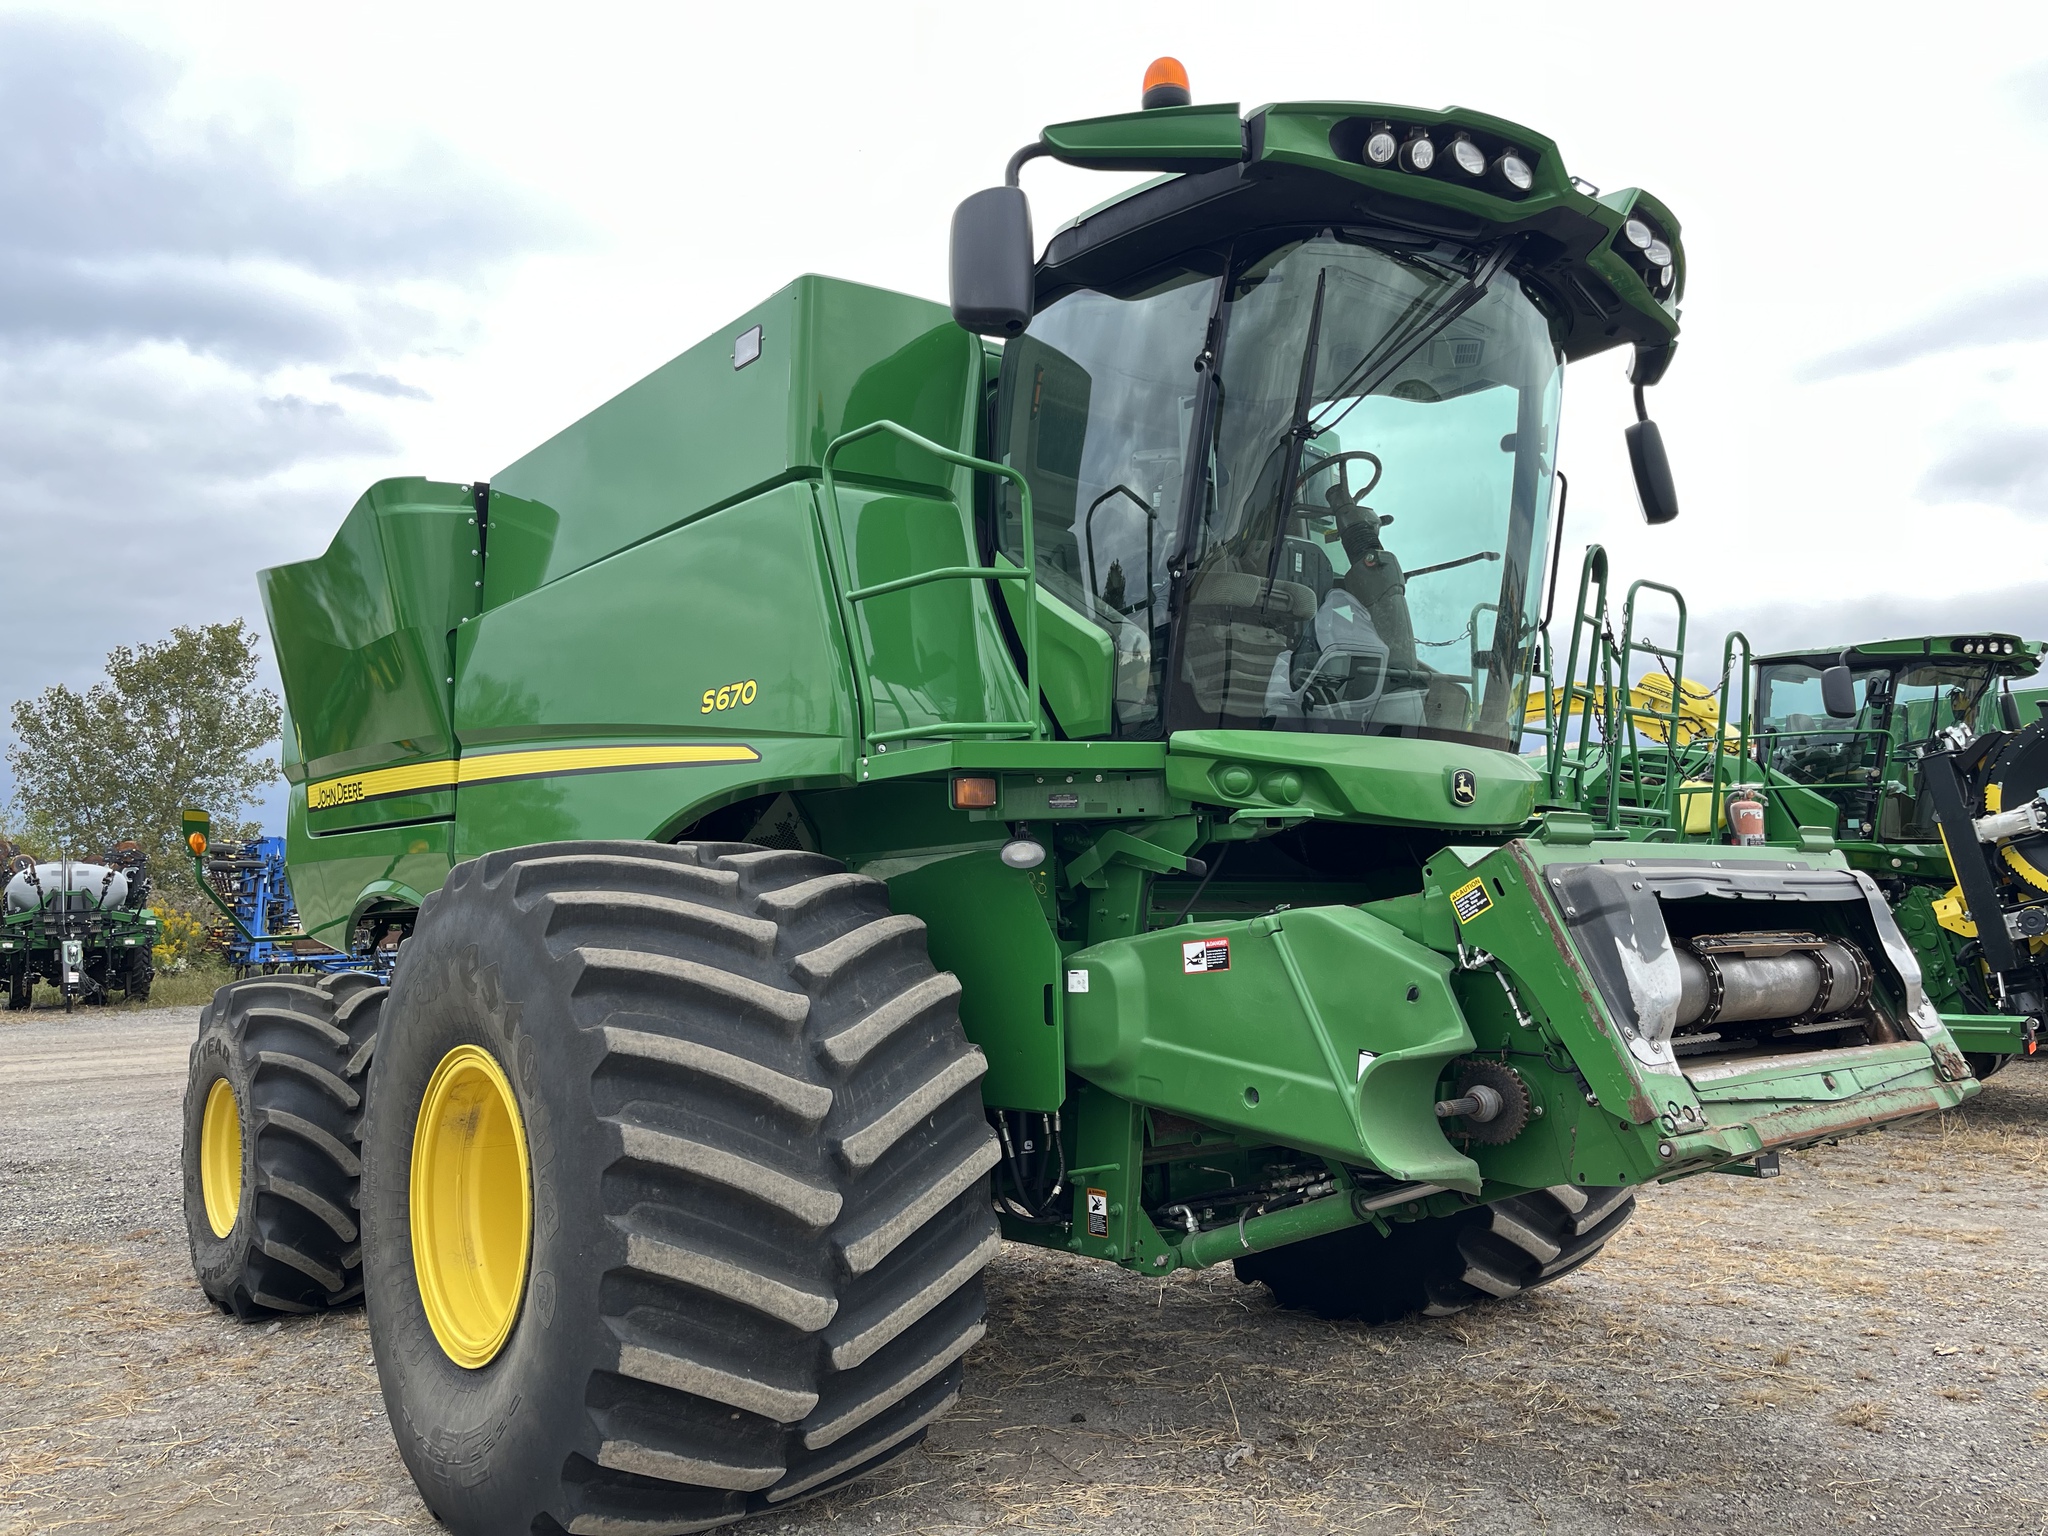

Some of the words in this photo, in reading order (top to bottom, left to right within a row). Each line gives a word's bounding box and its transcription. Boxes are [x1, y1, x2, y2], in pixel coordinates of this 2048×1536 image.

[700, 679, 758, 715] S670
[317, 787, 337, 807] JOHN
[337, 781, 364, 801] DEERE
[1455, 878, 1481, 898] CAUTION
